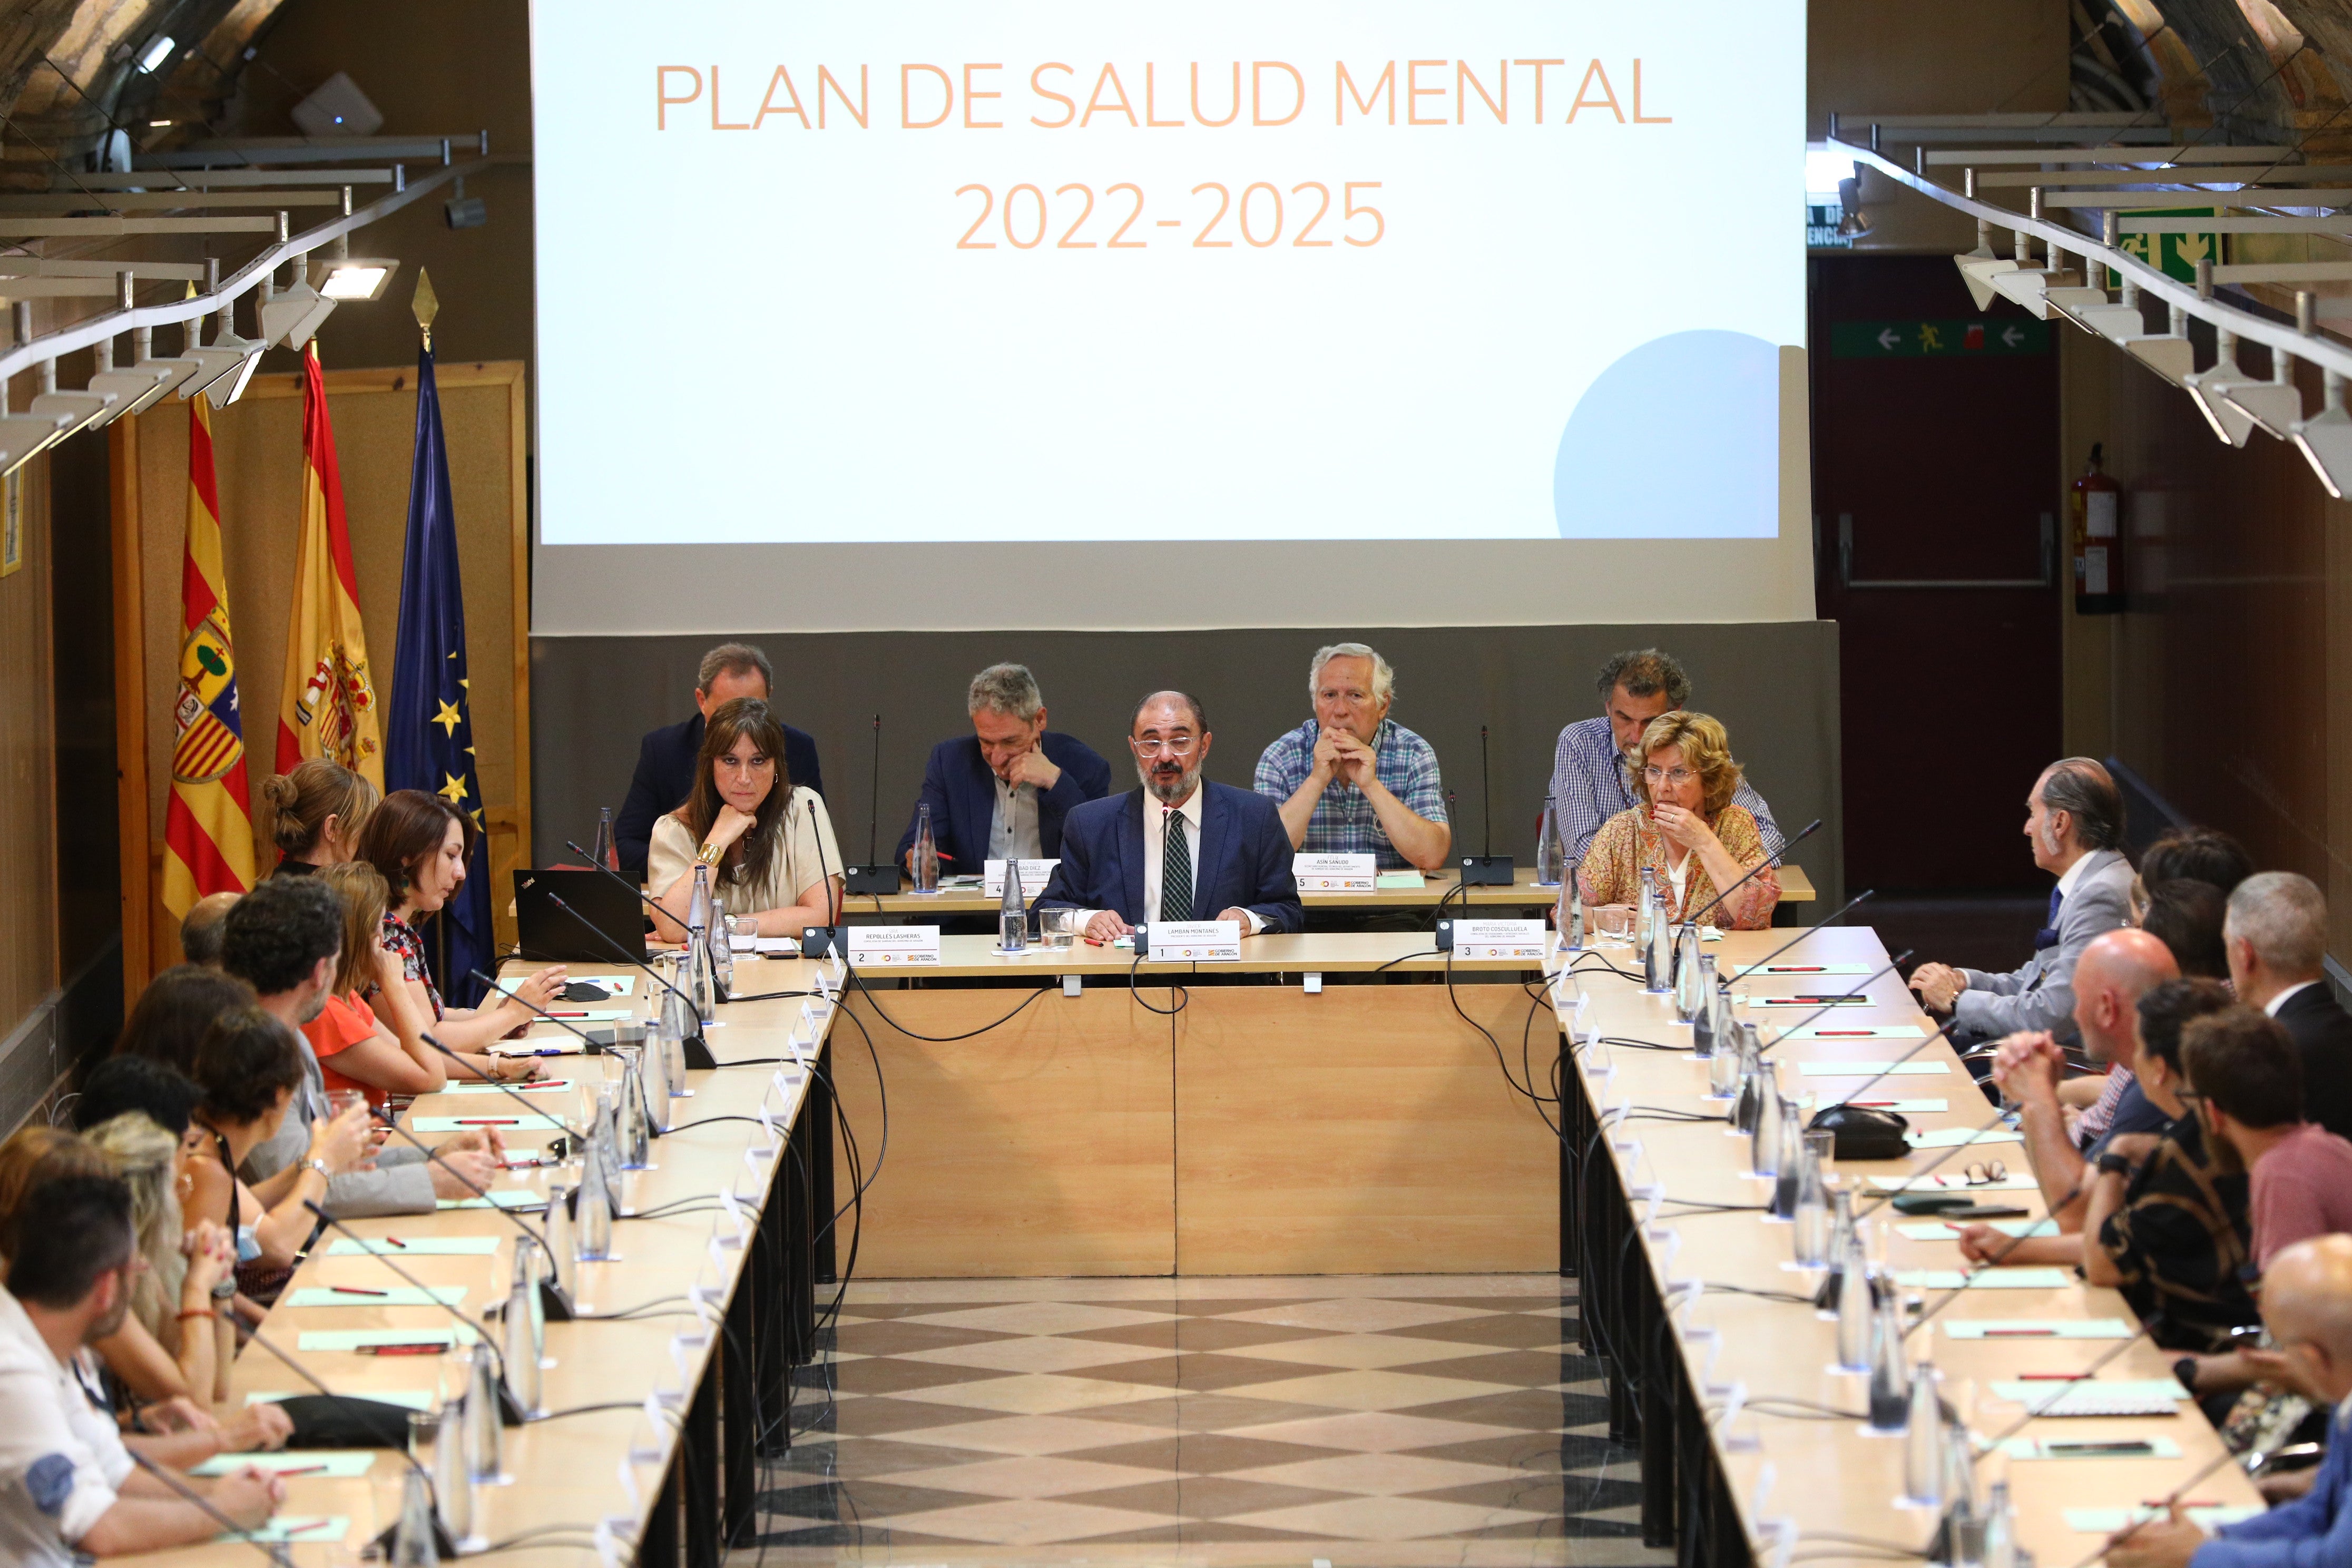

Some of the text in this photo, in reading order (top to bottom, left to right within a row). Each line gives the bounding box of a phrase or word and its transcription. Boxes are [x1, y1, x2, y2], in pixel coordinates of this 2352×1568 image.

[657, 58, 1672, 130] PLAN DE SALUD MENTAL
[955, 181, 1384, 249] 2022-2025
[1299, 878, 1305, 887] 5
[1160, 948, 1164, 957] 1
[1465, 947, 1471, 956] 3
[859, 953, 865, 962] 2
